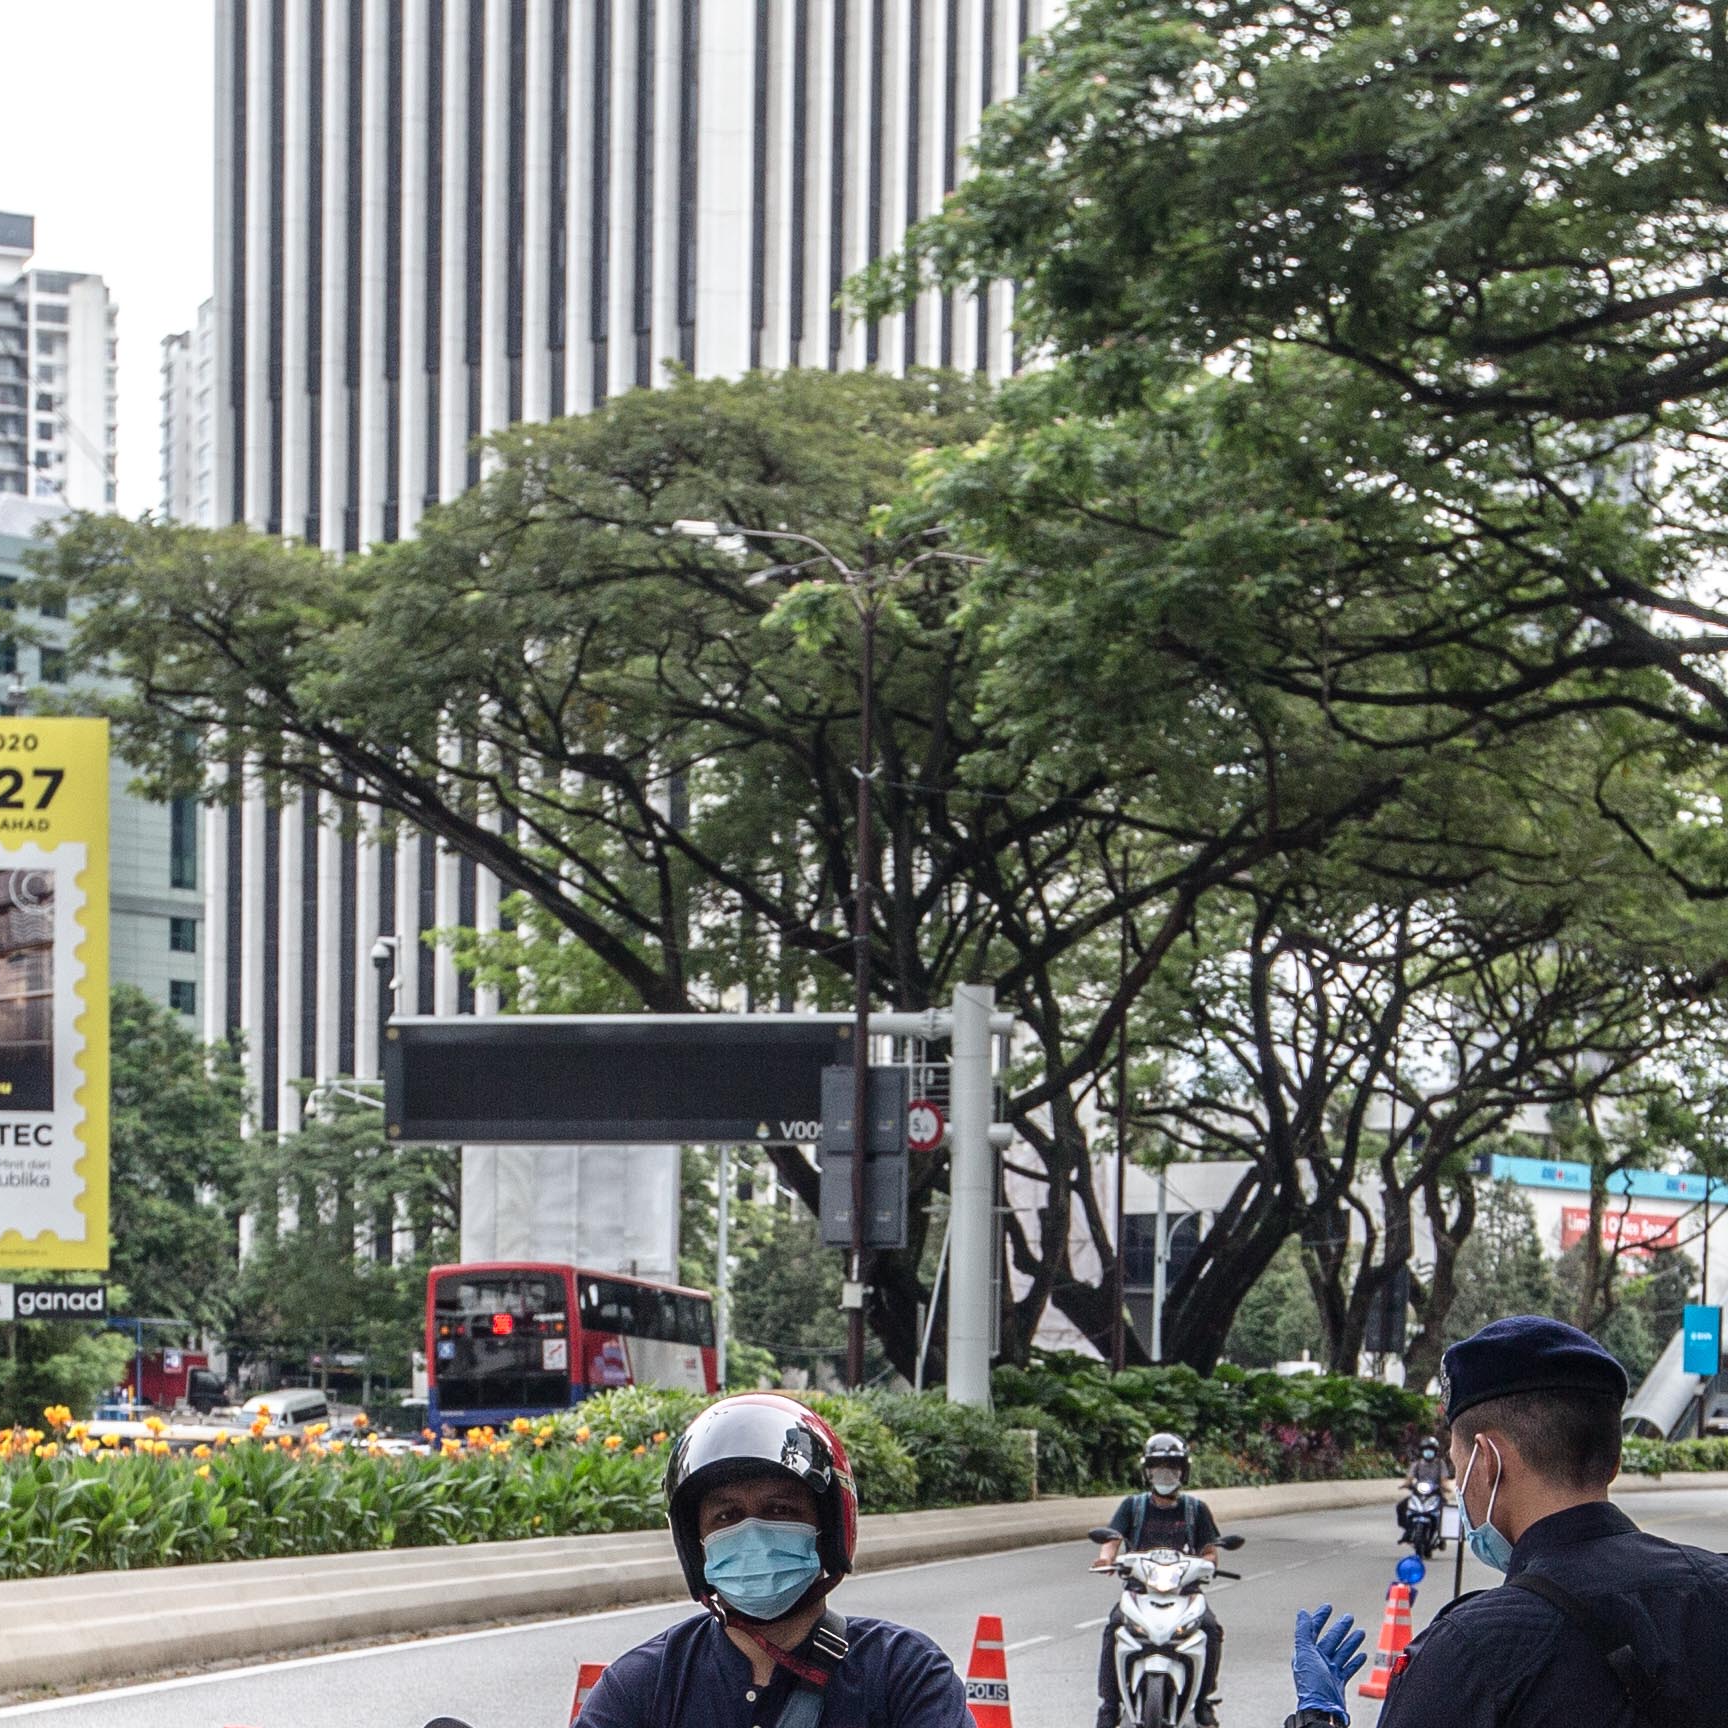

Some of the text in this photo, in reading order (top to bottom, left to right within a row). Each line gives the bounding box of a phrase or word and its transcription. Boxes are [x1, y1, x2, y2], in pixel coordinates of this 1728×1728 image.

[0, 818, 50, 831] AHAD
[17, 1288, 104, 1315] ganad
[965, 1683, 1007, 1700] POLIS
